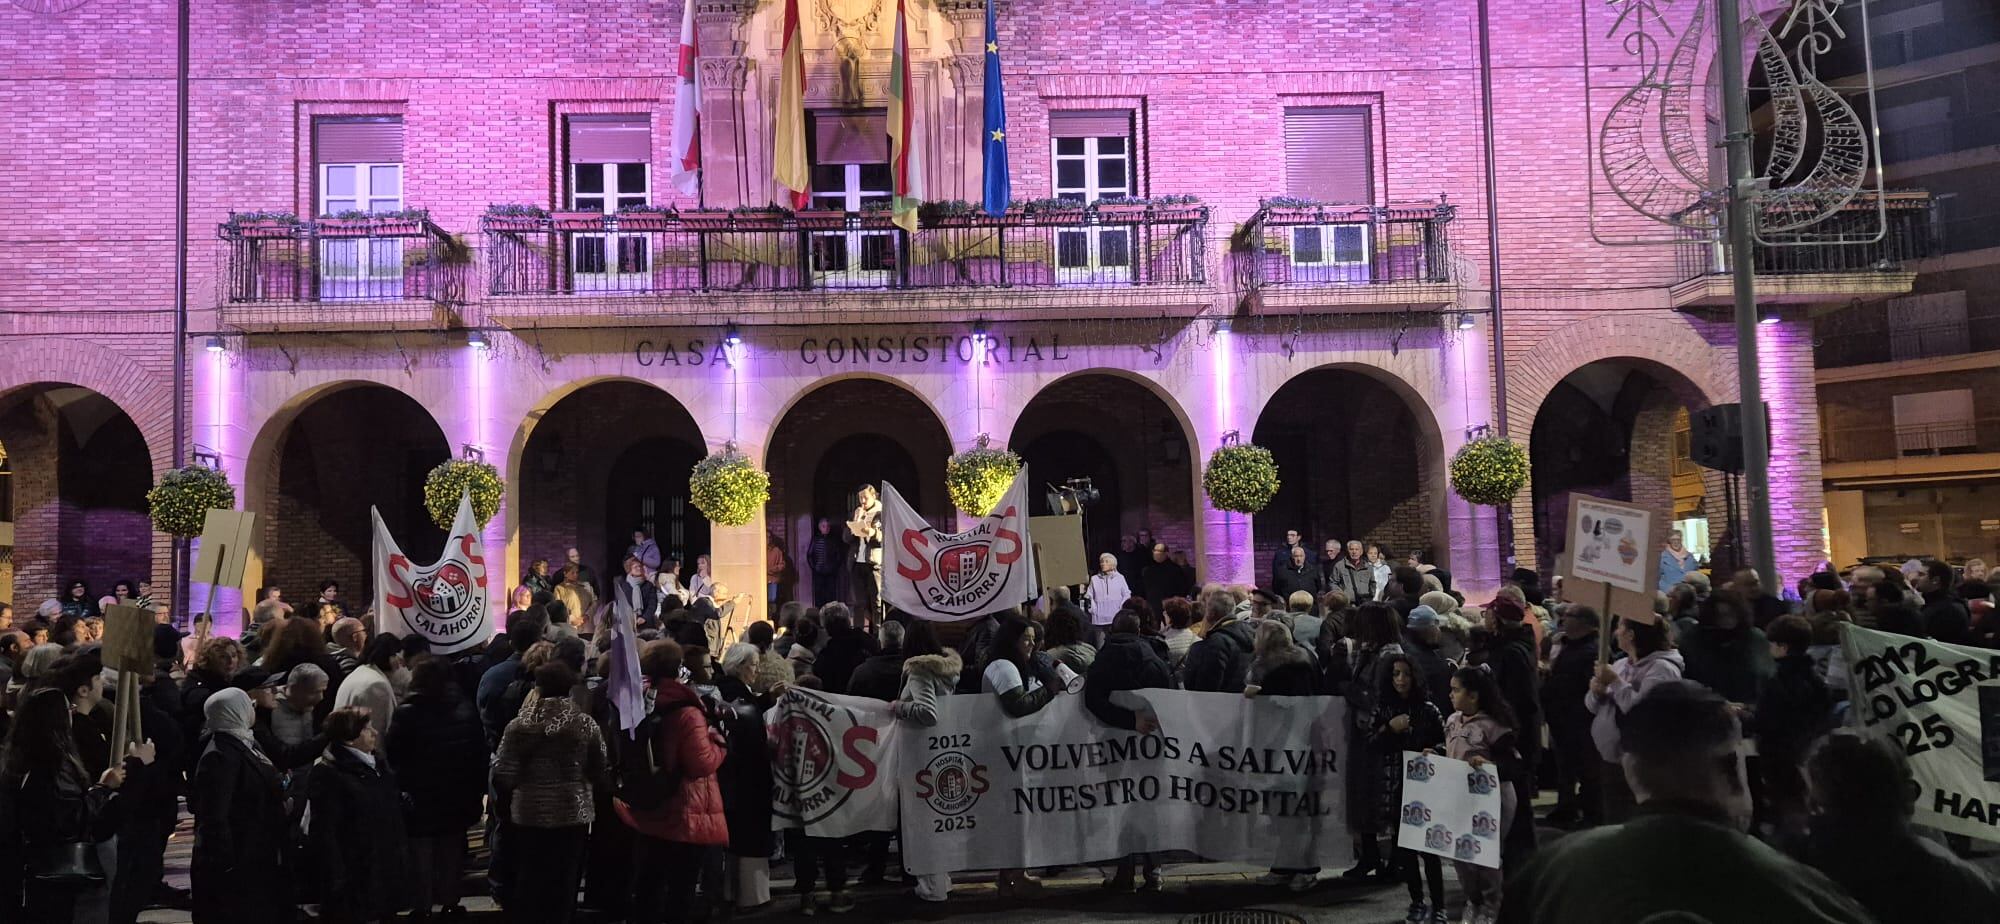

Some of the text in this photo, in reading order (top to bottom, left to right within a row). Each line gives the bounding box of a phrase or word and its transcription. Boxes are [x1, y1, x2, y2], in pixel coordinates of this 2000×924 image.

[635, 333, 1069, 367] CASA CONSISTORIAL
[415, 595, 482, 636] CALAHORRA
[928, 734, 971, 750] 2012
[1001, 734, 1337, 776] VOLVEMOS A SALVAR
[1013, 775, 1331, 816] NUESTRO HOSPITAL
[934, 816, 976, 832] 2025
